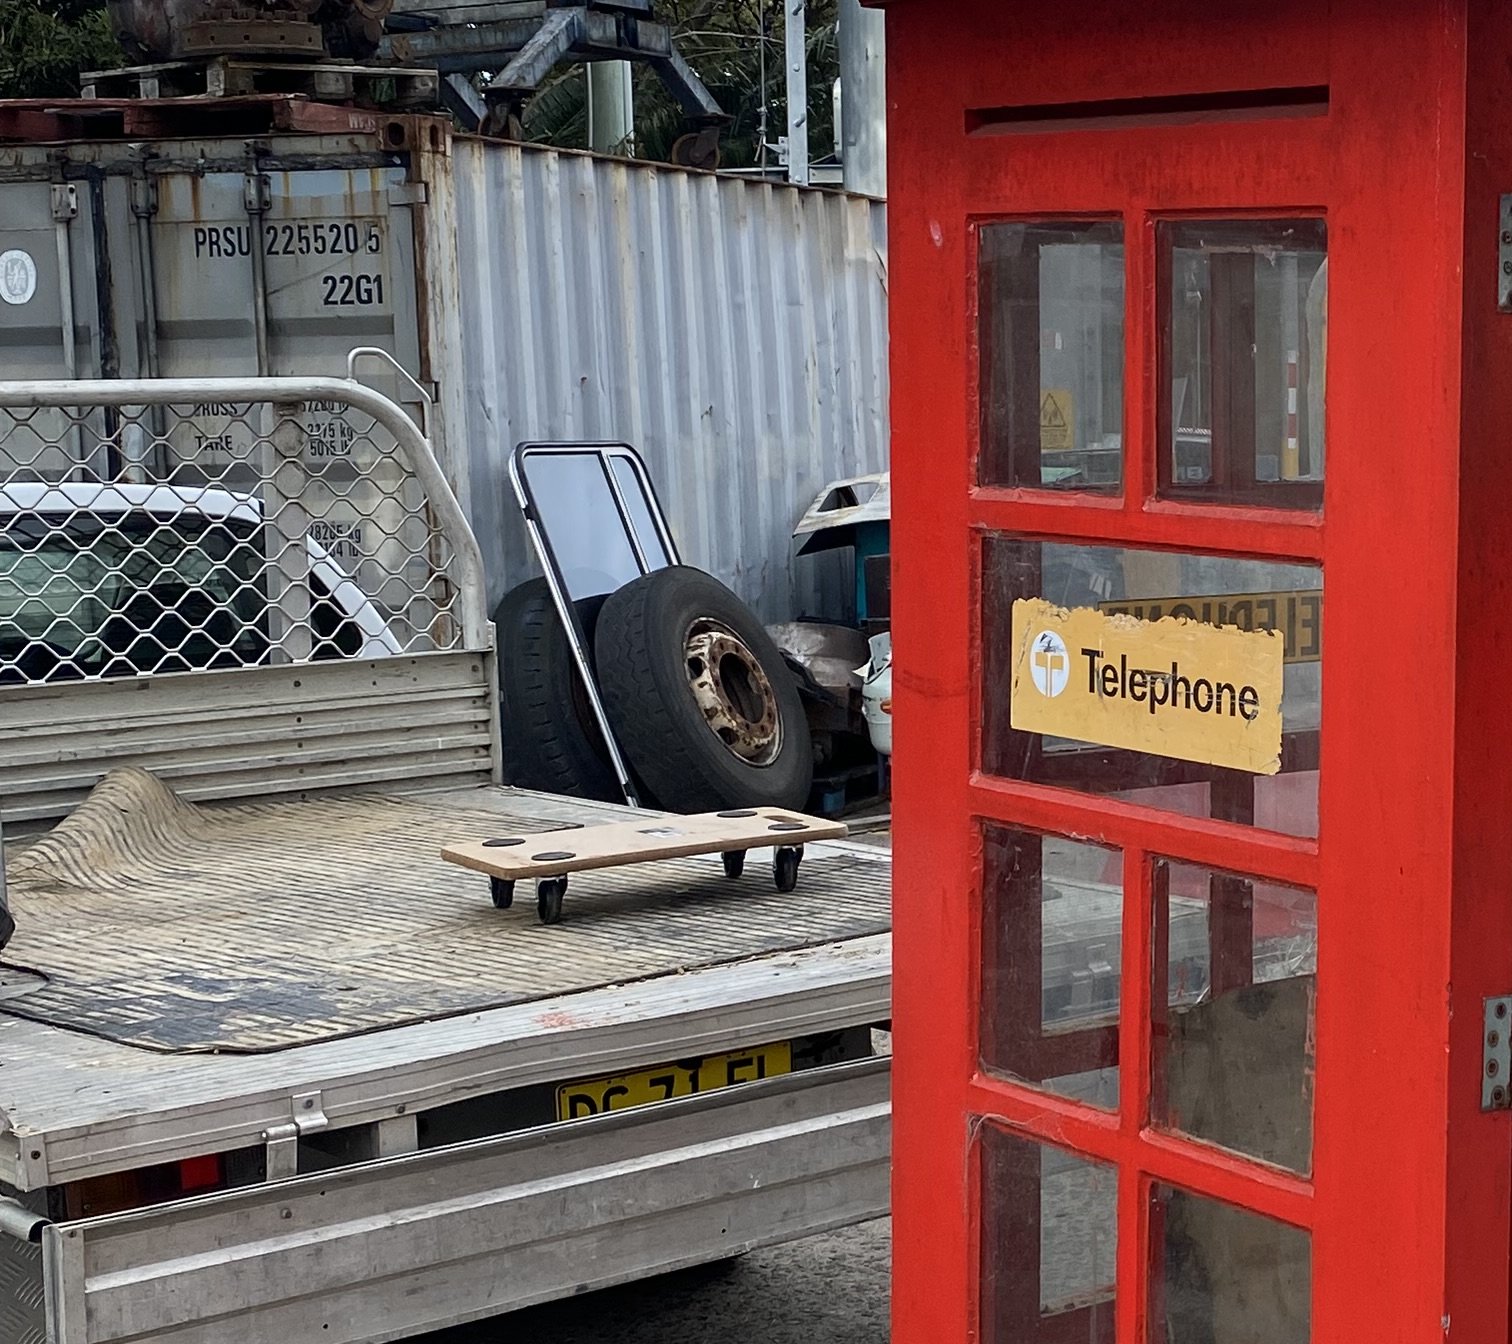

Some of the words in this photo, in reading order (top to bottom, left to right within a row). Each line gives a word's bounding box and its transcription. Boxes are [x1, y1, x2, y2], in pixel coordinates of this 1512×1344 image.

[194, 226, 250, 258] PRSU
[265, 224, 358, 256] 225520
[322, 274, 384, 306] 22G1
[194, 435, 233, 452] TARE
[1081, 647, 1260, 721] Telephone
